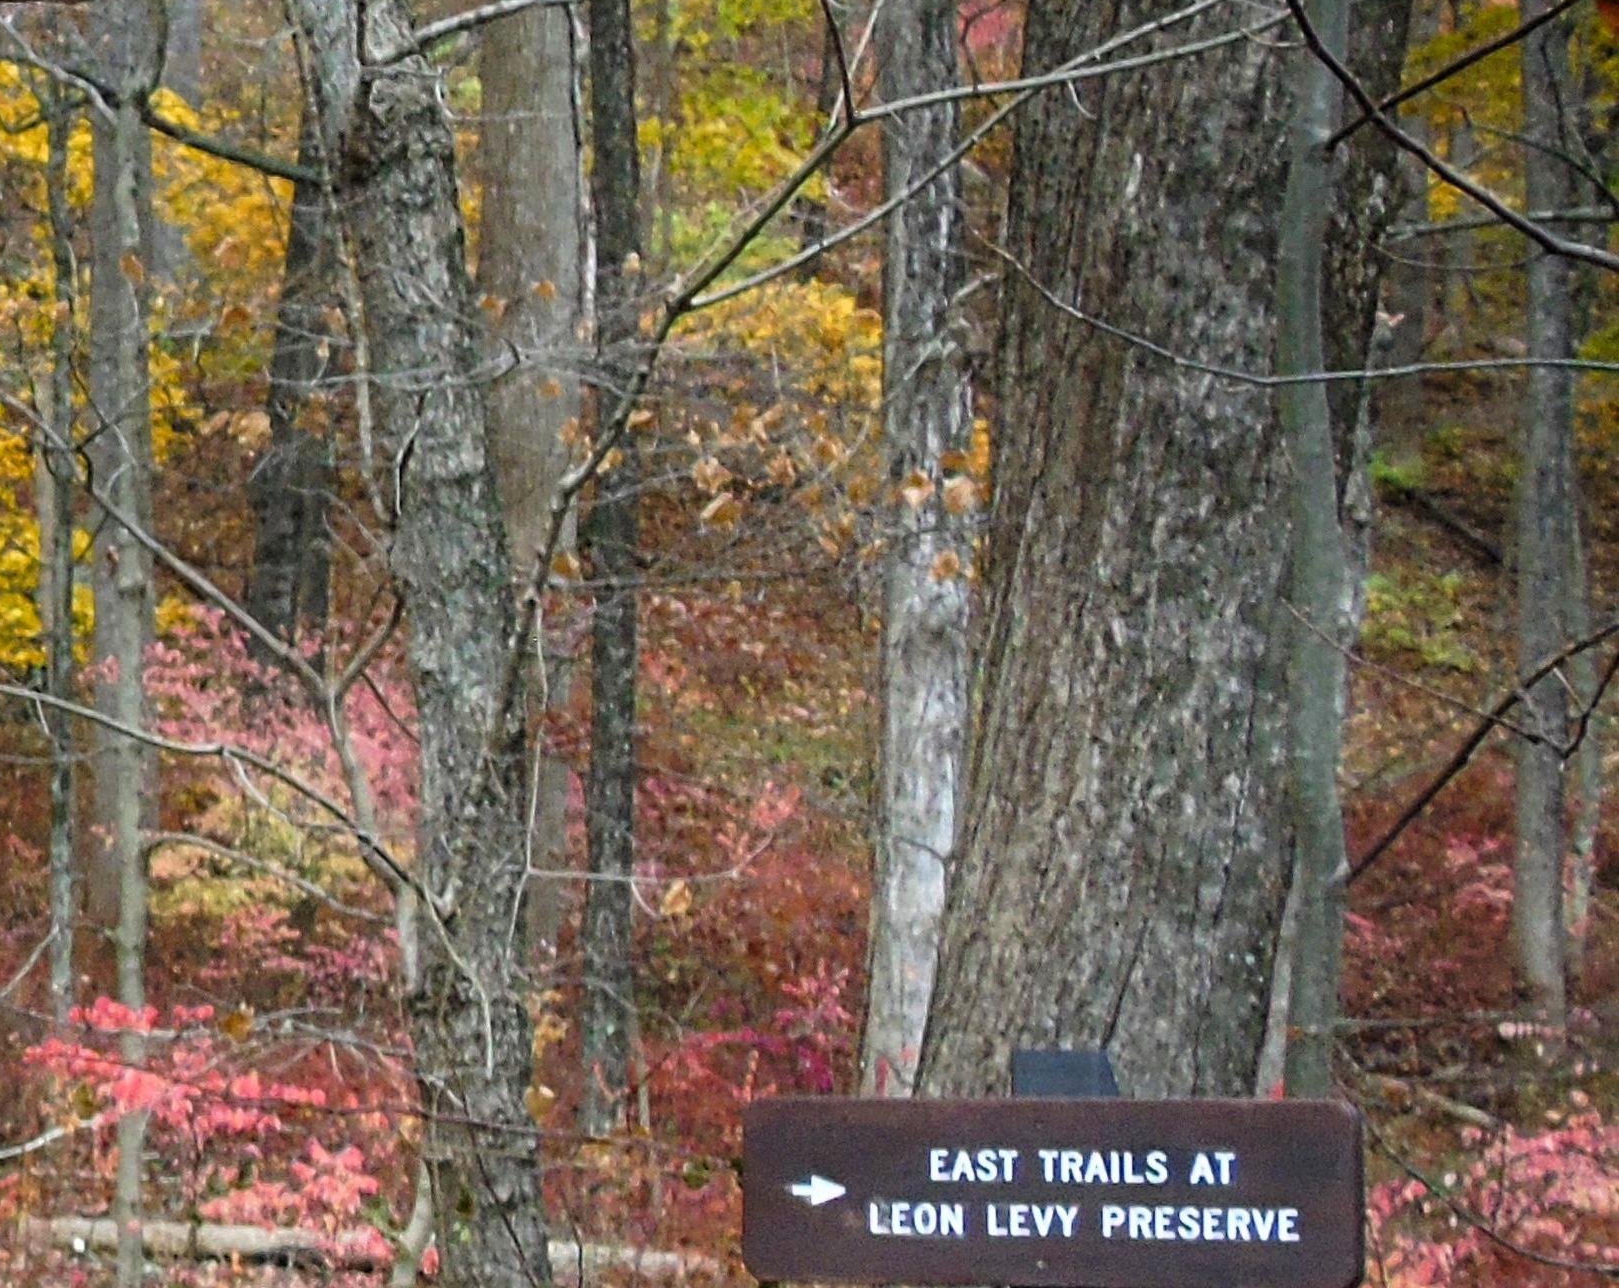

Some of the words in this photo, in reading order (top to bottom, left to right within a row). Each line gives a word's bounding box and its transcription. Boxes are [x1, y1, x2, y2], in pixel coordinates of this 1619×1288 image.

[929, 1149, 1018, 1183] EAST
[1038, 1150, 1168, 1185] TRAILS
[1189, 1151, 1236, 1186] AT
[869, 1203, 964, 1236] LEON
[987, 1204, 1078, 1238] LEVY
[1102, 1206, 1301, 1243] PRESERVE
